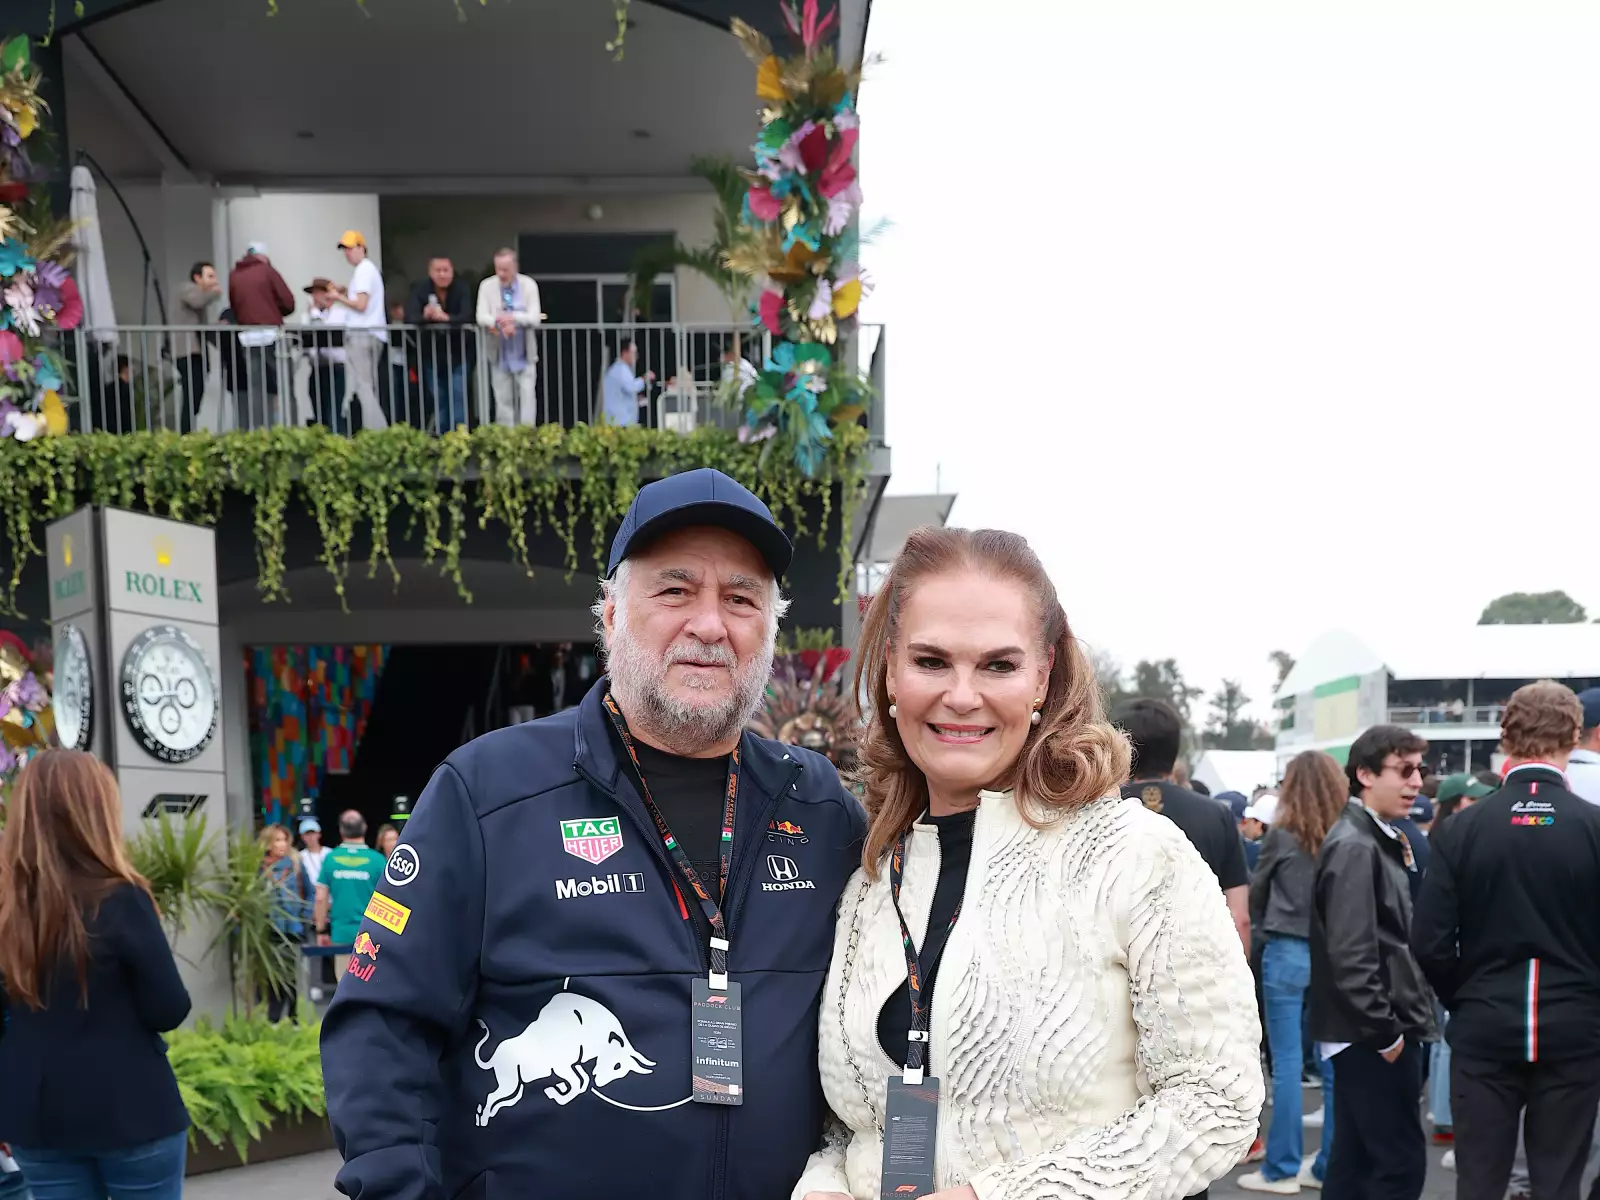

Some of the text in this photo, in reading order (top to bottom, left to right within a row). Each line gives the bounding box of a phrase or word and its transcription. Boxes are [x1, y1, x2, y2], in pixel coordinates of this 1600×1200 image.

[126, 570, 202, 603] ROLEX
[566, 821, 615, 837] TAG
[567, 838, 619, 861] HEUER
[555, 874, 620, 900] Mobil
[761, 880, 816, 892] HONDA
[696, 1056, 739, 1067] infinitum
[700, 1094, 737, 1102] SUNDAY
